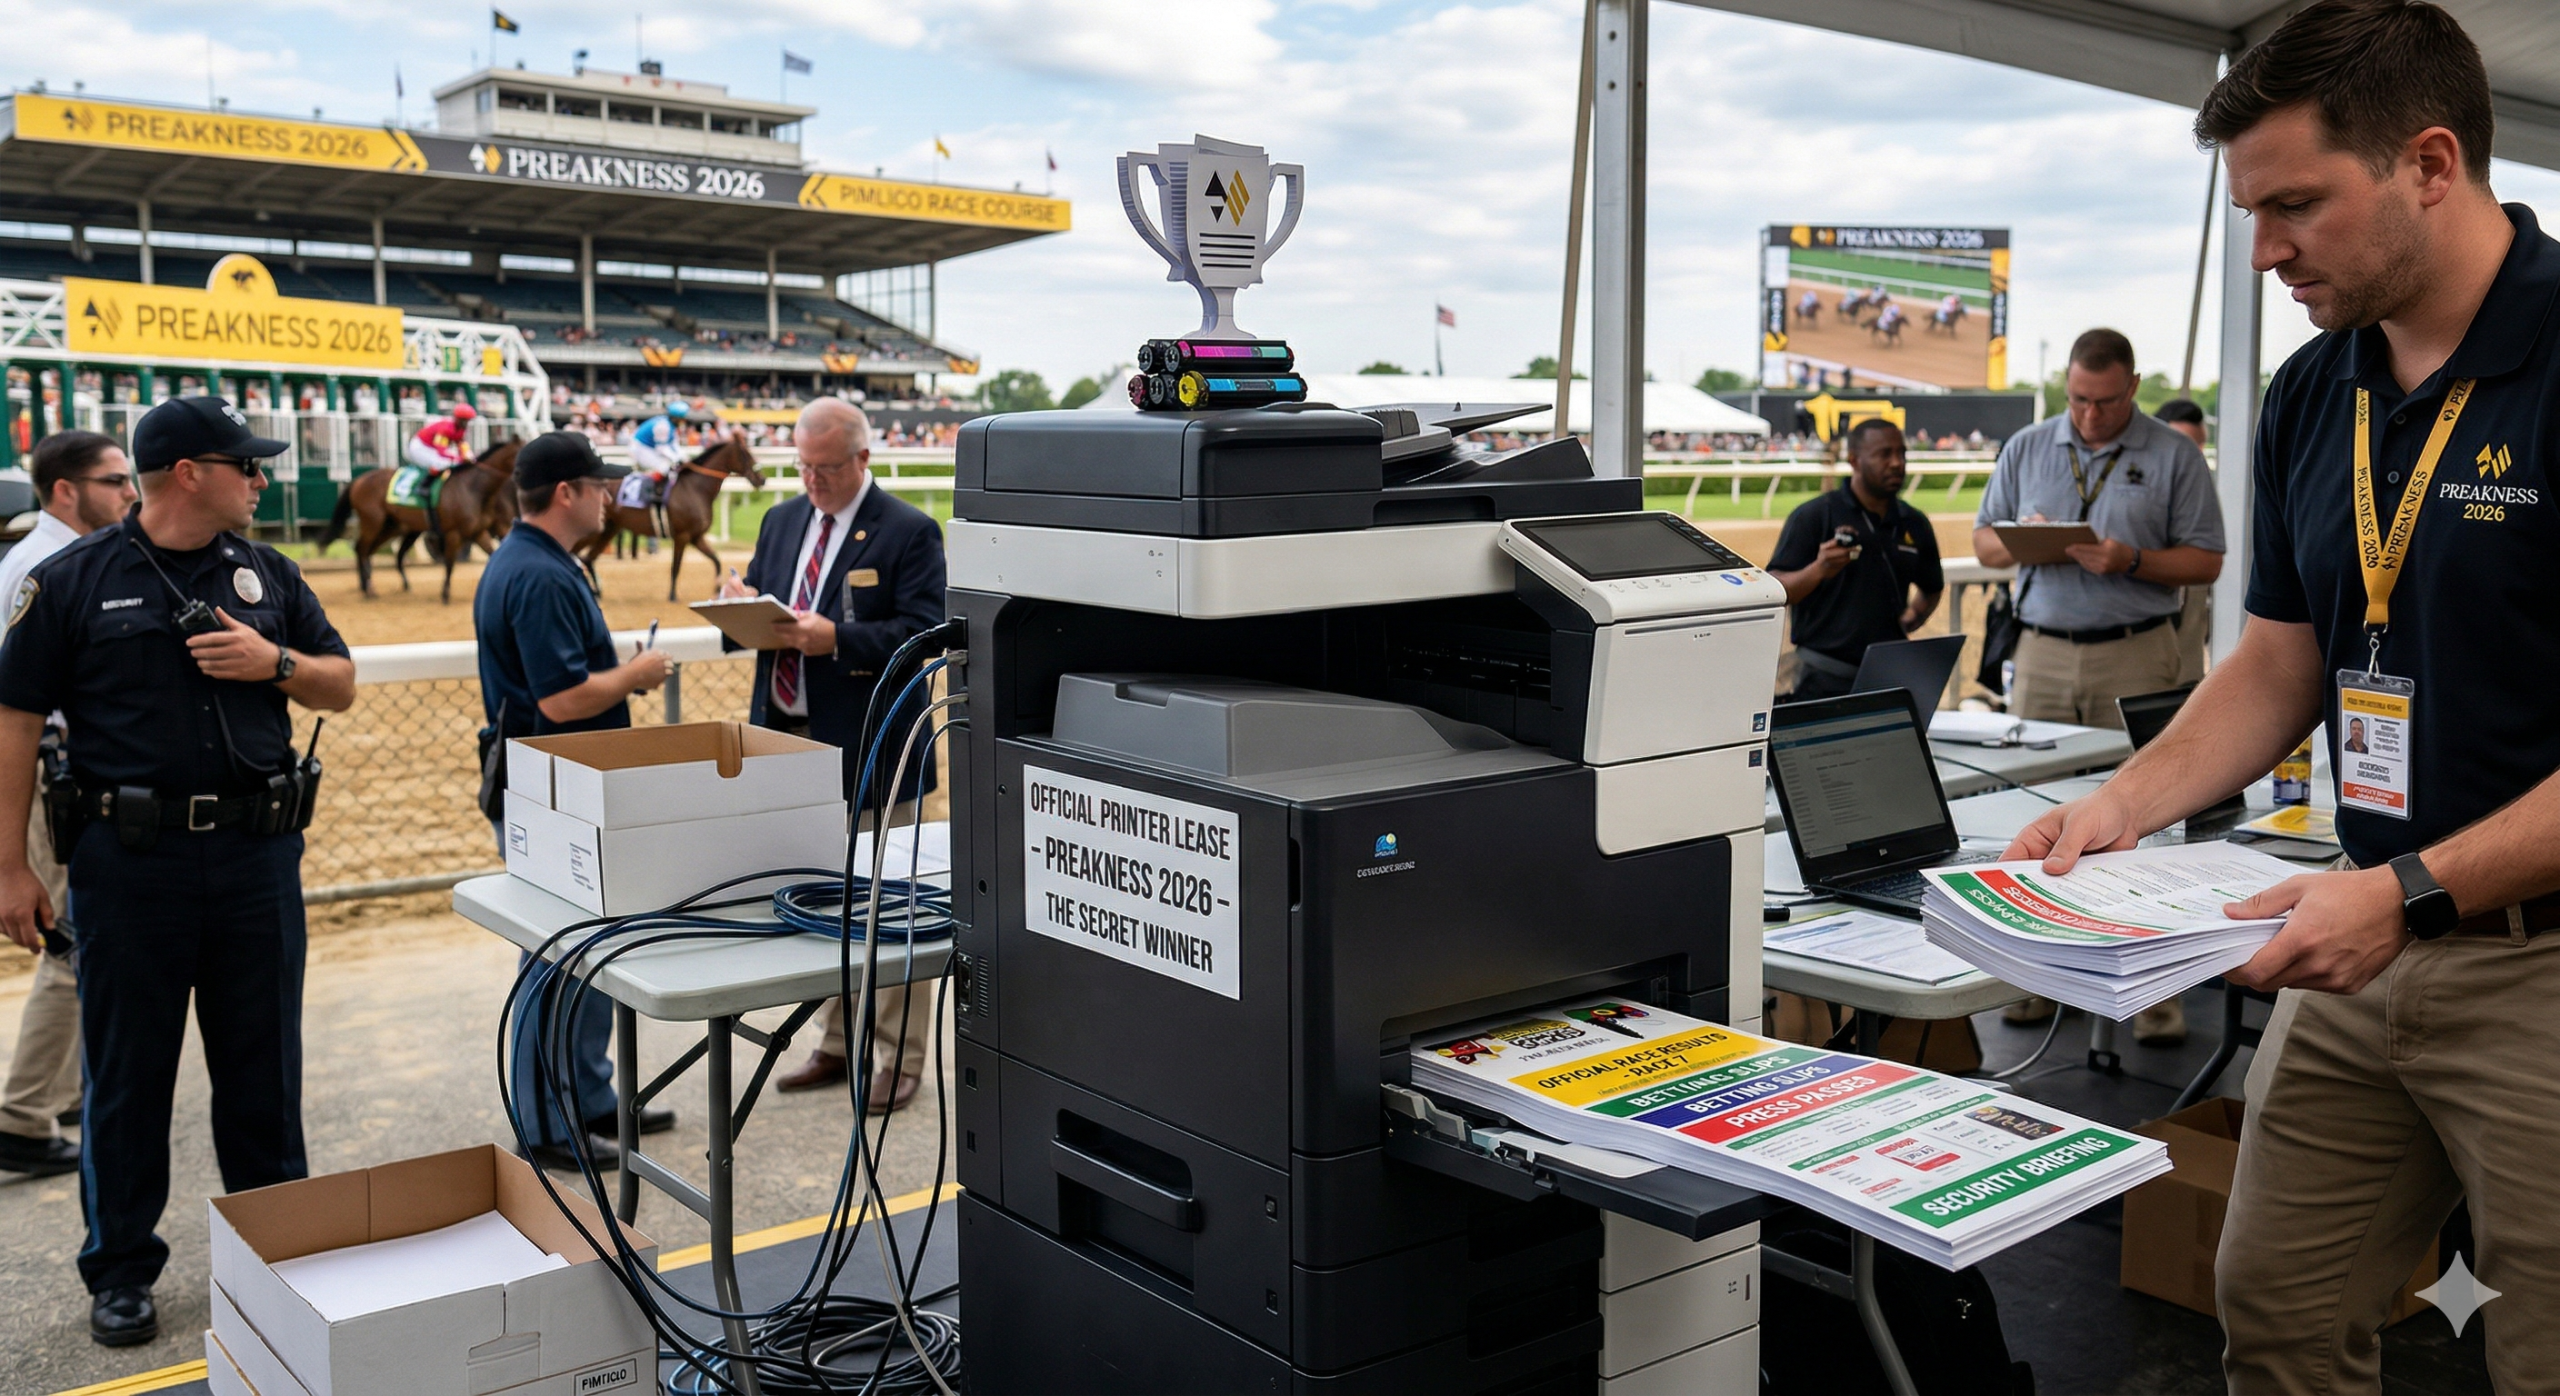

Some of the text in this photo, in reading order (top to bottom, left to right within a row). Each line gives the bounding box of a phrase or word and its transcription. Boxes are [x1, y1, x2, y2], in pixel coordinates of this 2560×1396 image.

[105, 110, 370, 160] PREAKNESS 2026
[507, 147, 766, 199] PREAKNESS 2026
[839, 184, 1058, 223] PIMLICO RACE COURSE
[136, 304, 320, 348] PREAKNESS
[329, 319, 393, 354] 2026
[2439, 483, 2539, 505] PREAKNESS
[2462, 503, 2506, 522] 2026
[1030, 782, 1231, 861] OFFICIAL PRINTER LEASE
[1045, 836, 1153, 899] PREAKNESS
[1159, 868, 1213, 916] 2026
[1045, 891, 1213, 974] THE SECRET WINNER
[1537, 1062, 1619, 1090] OFFICIAL
[1619, 1048, 1658, 1069] RACE
[1656, 1032, 1729, 1059] RESULTS
[1626, 1072, 1734, 1108] BETTING
[1733, 1054, 1792, 1077] SLIPS
[1675, 1055, 1690, 1065] 7
[1684, 1065, 1832, 1114] BETTING SLIPS
[1724, 1098, 1803, 1129] PRESS
[1793, 1074, 1877, 1105] PASSES
[1921, 1168, 2027, 1217] SECURITY
[2018, 1136, 2112, 1177] BRIEFING
